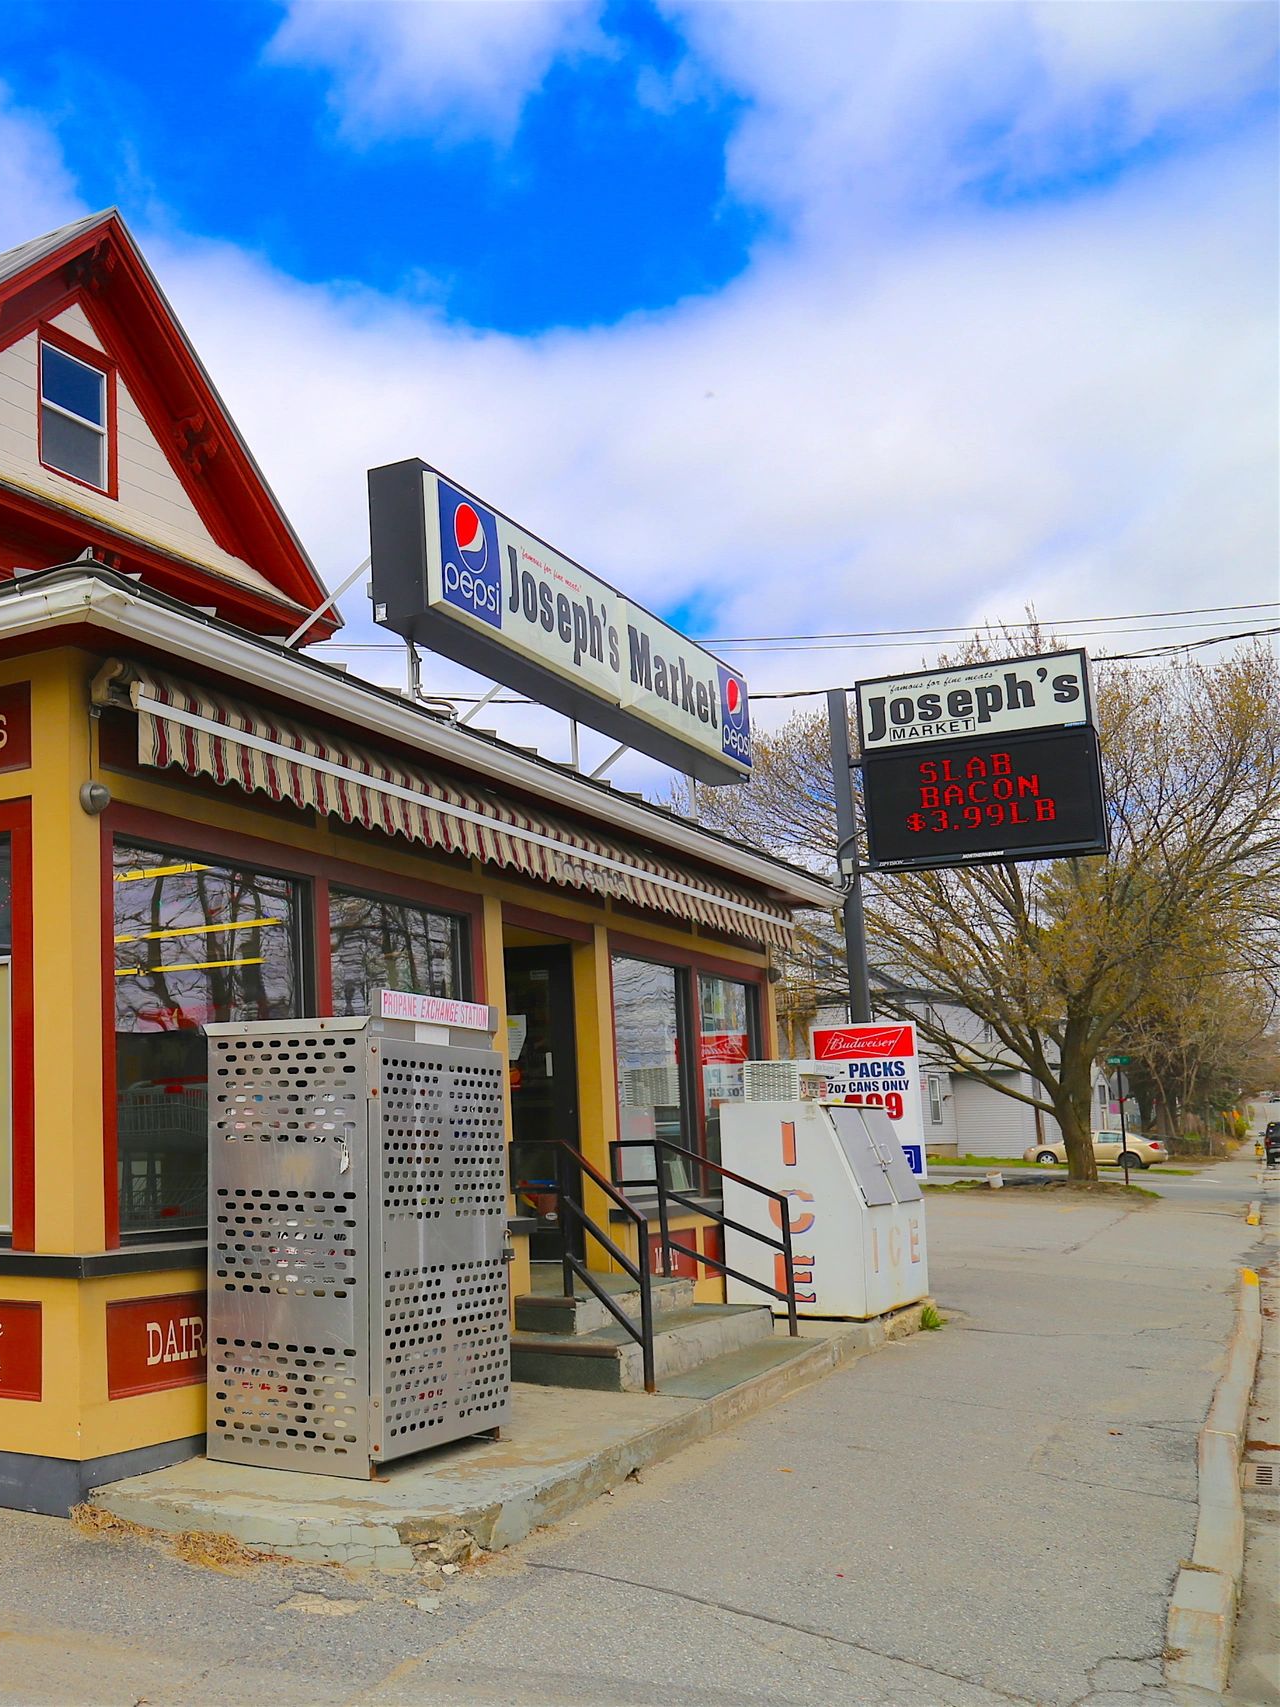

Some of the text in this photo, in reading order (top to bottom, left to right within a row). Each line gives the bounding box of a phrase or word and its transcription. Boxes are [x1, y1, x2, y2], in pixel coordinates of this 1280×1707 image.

[444, 561, 501, 615] pepsi
[507, 544, 718, 730] Joseph's Market
[927, 680, 940, 689] for
[943, 677, 961, 687] fine
[868, 667, 1080, 742] Joseph's
[723, 724, 751, 758] pepsi
[892, 720, 972, 740] MARKET
[919, 752, 1014, 784] SLAB
[919, 774, 1040, 809] BACON
[383, 993, 488, 1028] PROPANE EXCHANGE STATION
[827, 1037, 895, 1050] Budweiser
[849, 1061, 906, 1078] PACKS
[827, 1082, 846, 1094] 2oz
[849, 1081, 879, 1093] CANS
[882, 1080, 910, 1092] ONLY
[147, 1316, 207, 1365] DAIR
